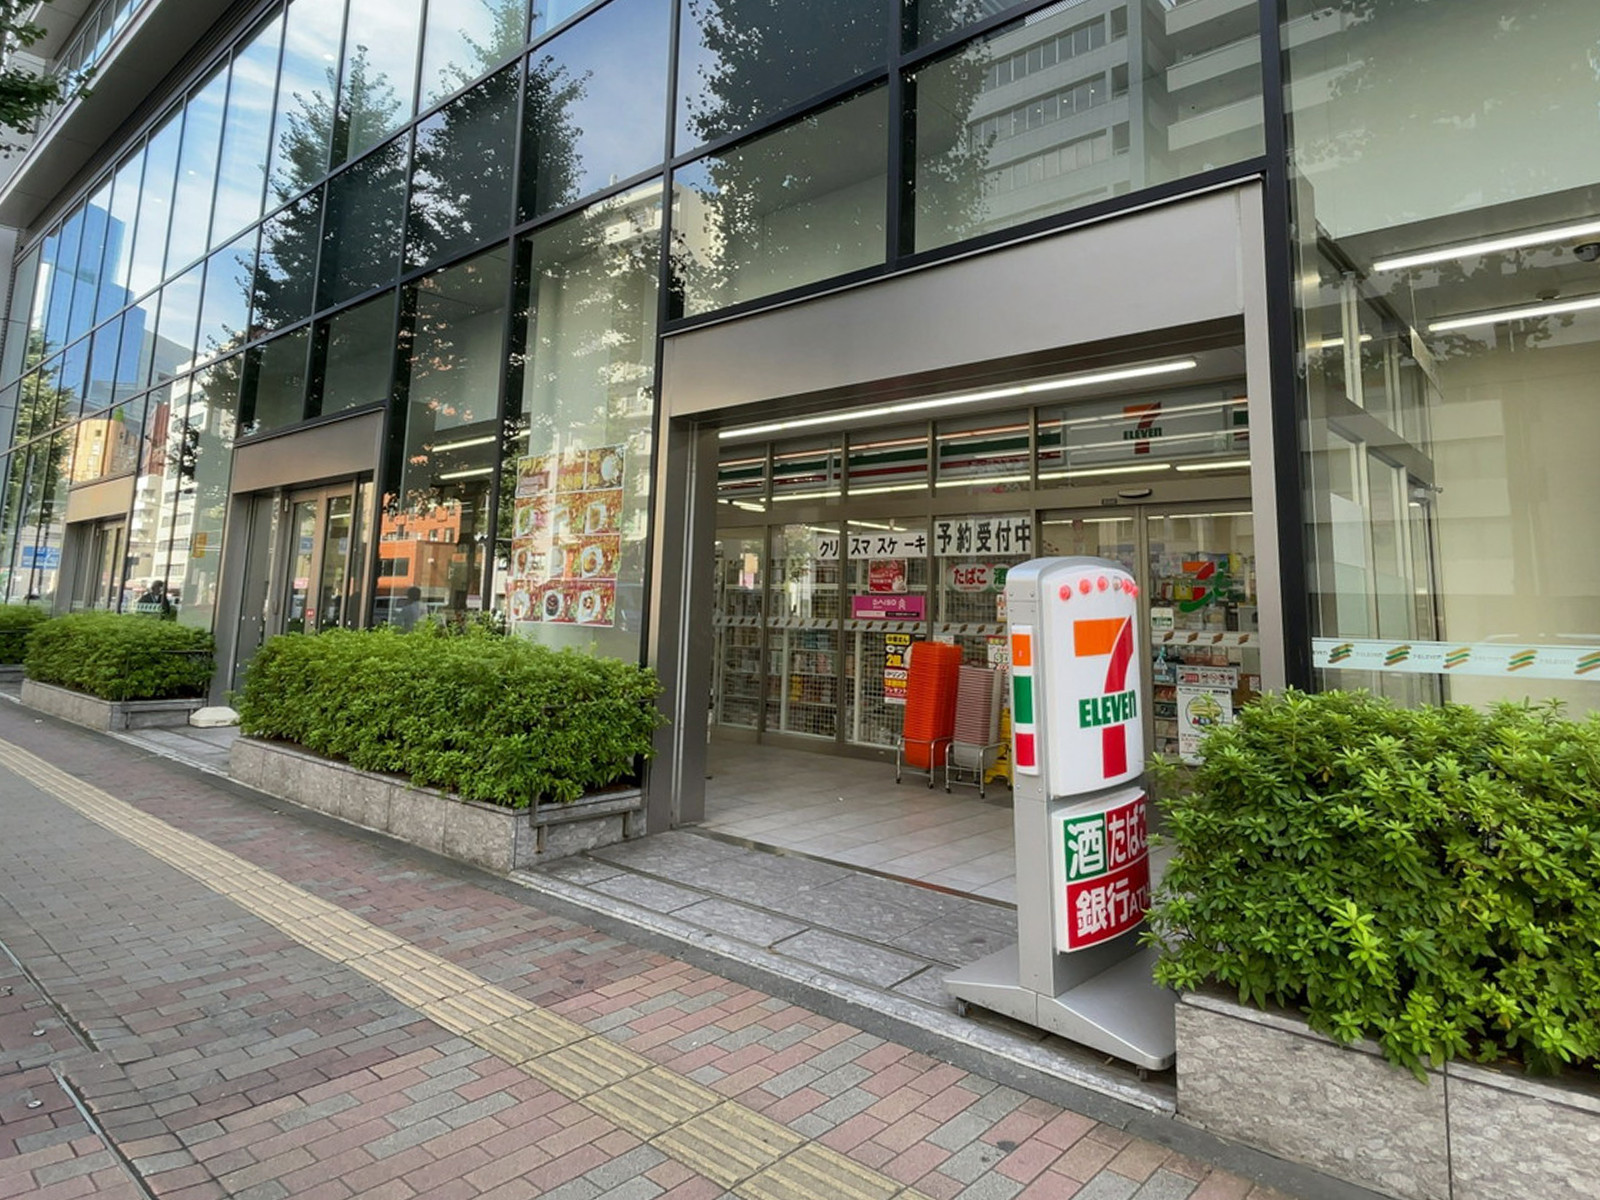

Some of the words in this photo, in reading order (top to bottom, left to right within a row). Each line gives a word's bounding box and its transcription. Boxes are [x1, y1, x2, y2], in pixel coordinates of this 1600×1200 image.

[937, 520, 1030, 553] 予約受付中
[953, 567, 987, 585] たばこ
[1078, 690, 1137, 729] ELEVEn
[1067, 819, 1105, 878] 酒
